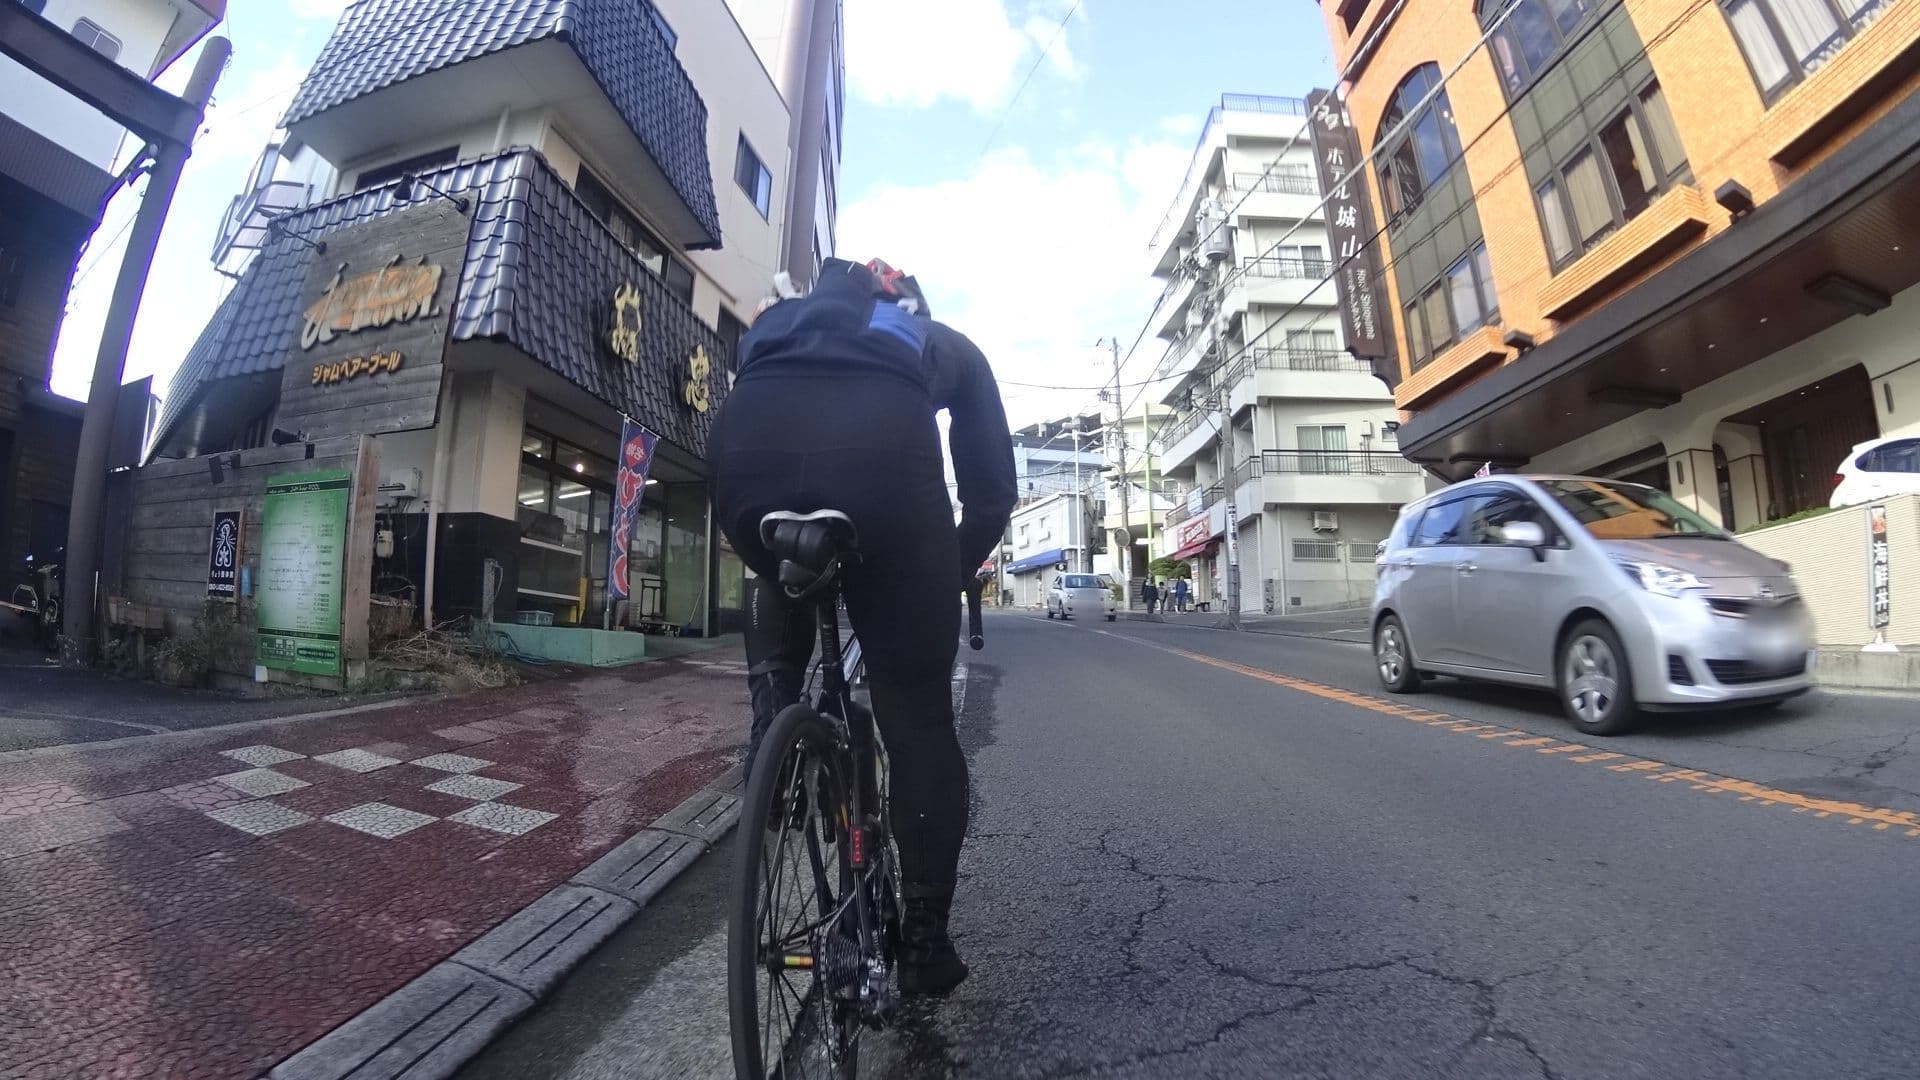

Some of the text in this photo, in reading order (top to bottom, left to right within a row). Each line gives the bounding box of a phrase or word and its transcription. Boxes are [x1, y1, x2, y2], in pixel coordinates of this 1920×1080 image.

[1326, 146, 1362, 259] ホテル城山
[312, 350, 402, 385] ジャムヘアープール
